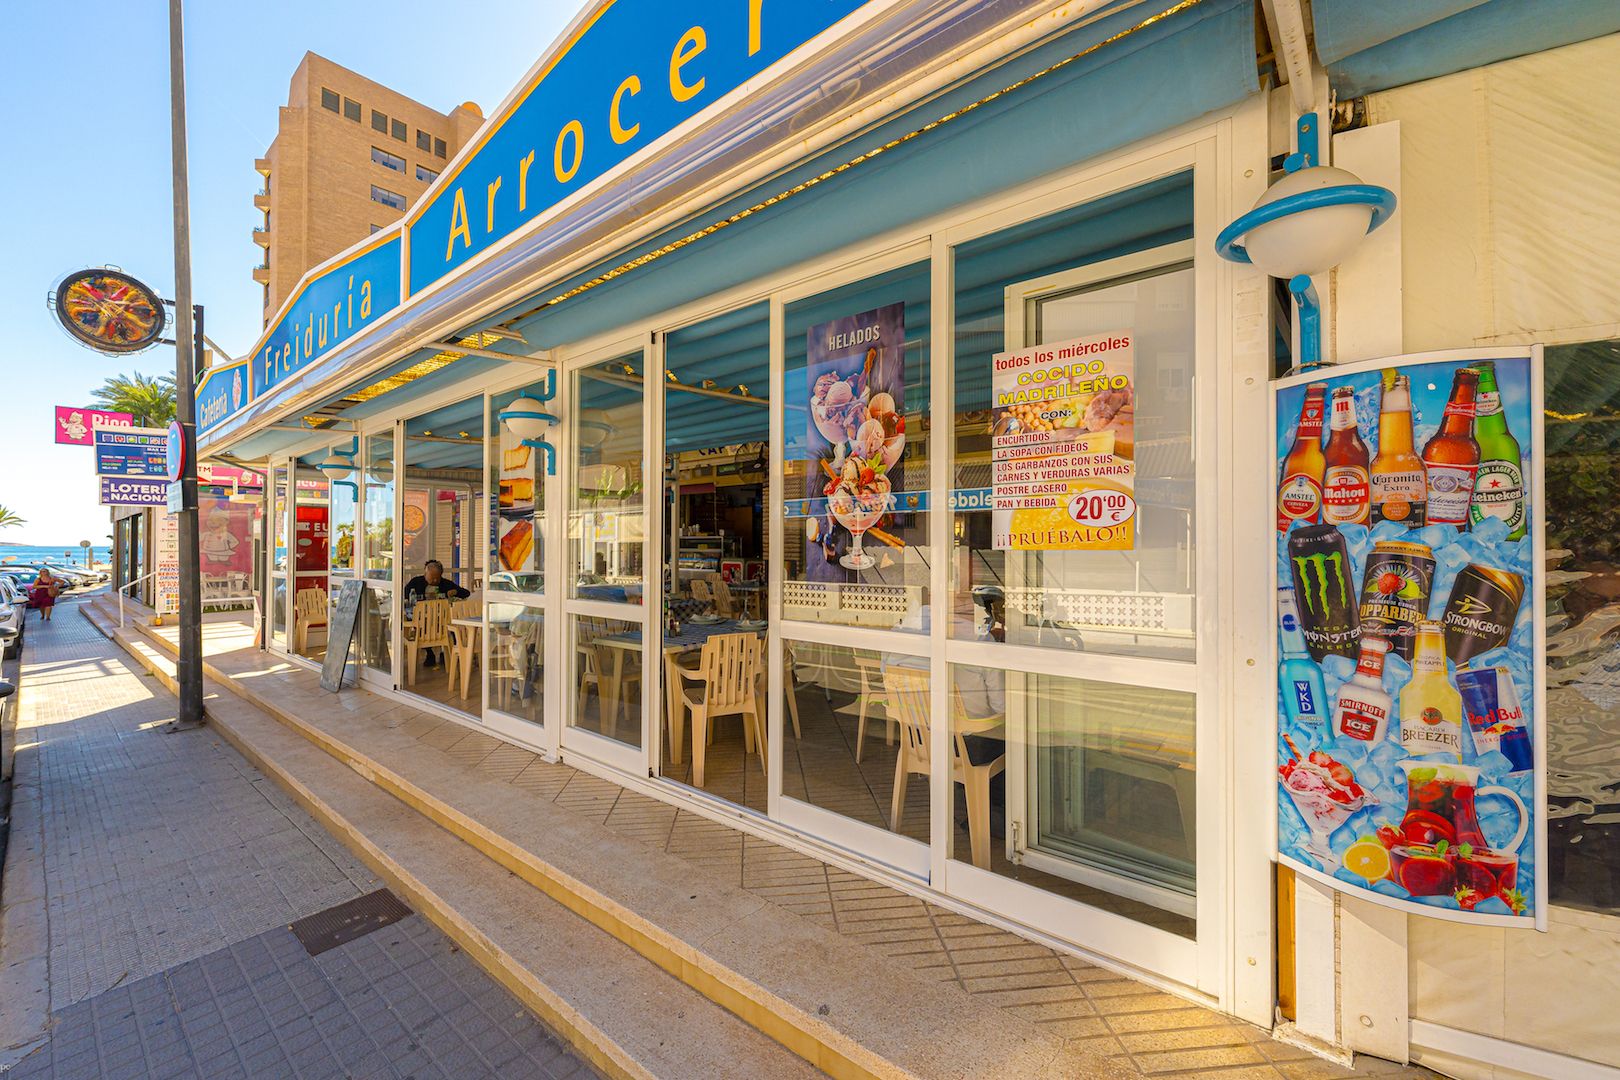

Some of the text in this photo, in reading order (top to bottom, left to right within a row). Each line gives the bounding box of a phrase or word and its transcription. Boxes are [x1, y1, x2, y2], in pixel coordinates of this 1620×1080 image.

[265, 275, 371, 386] Freiduría
[828, 324, 880, 352] HELADOS
[995, 337, 1130, 371] todos los miércoles
[1017, 359, 1105, 386] COCIDO
[998, 374, 1129, 406] MADRILEÑO
[200, 387, 228, 429] Cafetería
[1040, 409, 1072, 420] CON:
[1299, 420, 1323, 428] AMSTEL
[997, 432, 1050, 446] ENCURTIDOS
[997, 442, 1089, 459] LA SOPA CON FIDEOS
[997, 454, 1113, 472] LOS GARBANZOS CON SUS
[997, 464, 1130, 483] CARNES Y VERDURAS VARIAS
[1372, 474, 1423, 486] Coronita
[110, 482, 167, 495] LOTERÍ
[997, 483, 1067, 496] POSTRE CASERO
[1285, 492, 1314, 501] AMSTEL
[1324, 487, 1365, 499] Mahou
[110, 493, 168, 503] NACIONA
[997, 497, 1057, 508] PAN Y BEBIDA
[1506, 503, 1522, 526] UALITY
[997, 526, 1127, 547] ¡¡PRUÉBALO!!
[1360, 604, 1427, 623] OPPARBER
[1313, 624, 1349, 632] MEGA
[1444, 610, 1507, 636] STRONGBOW
[1451, 626, 1487, 640] ORIGINAL
[1359, 659, 1381, 670] ICE
[1296, 682, 1312, 712] WKD
[1340, 699, 1386, 719] SMIRNOFF
[1467, 705, 1523, 726] Red Bull
[1345, 719, 1372, 733] ICE
[1402, 728, 1460, 749] BREEZER
